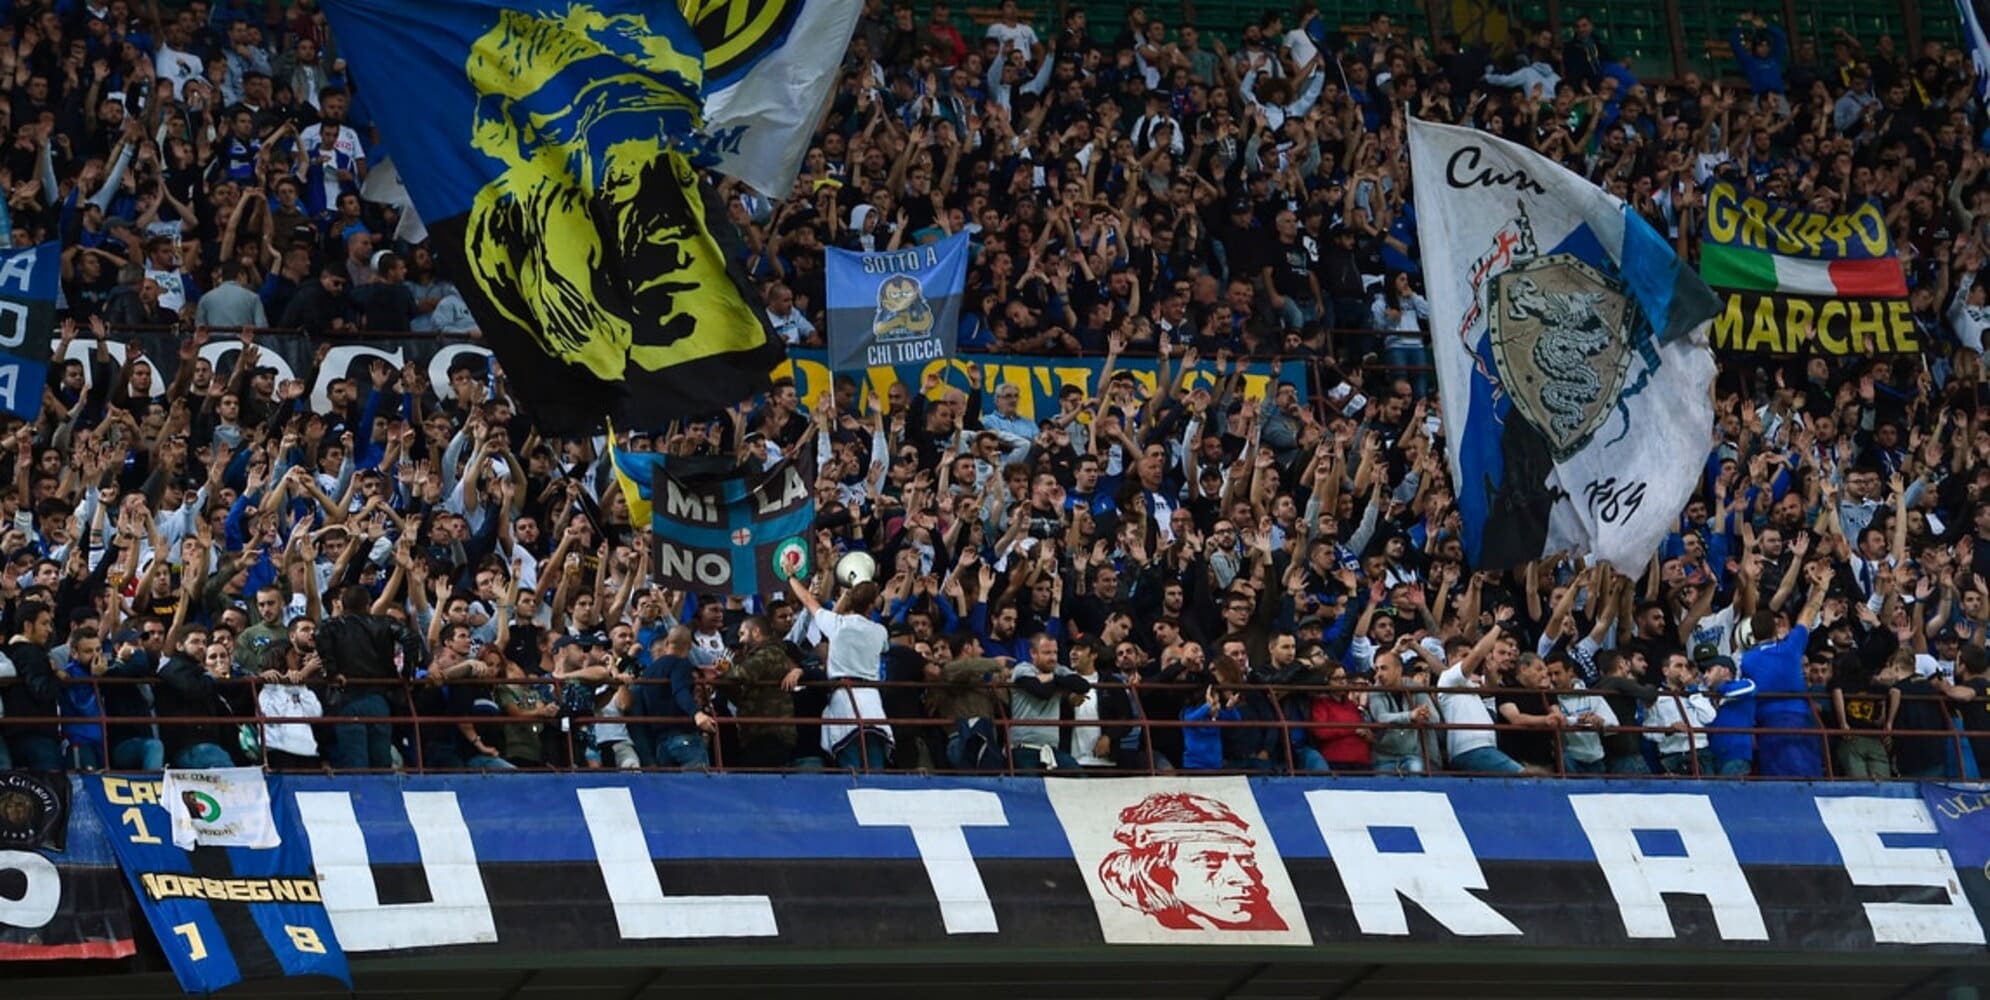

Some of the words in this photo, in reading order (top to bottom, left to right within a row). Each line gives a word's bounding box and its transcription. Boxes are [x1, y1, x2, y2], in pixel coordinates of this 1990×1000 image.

[1708, 182, 1888, 257] GRUPPO
[862, 251, 919, 274] SOTTO
[926, 246, 938, 267] A
[1707, 293, 1920, 355] MARCHE
[867, 345, 893, 366] CHI
[899, 338, 944, 362] TOCCA
[753, 465, 808, 514] LA
[662, 543, 731, 586] NO
[295, 787, 1987, 952] ULTRAS
